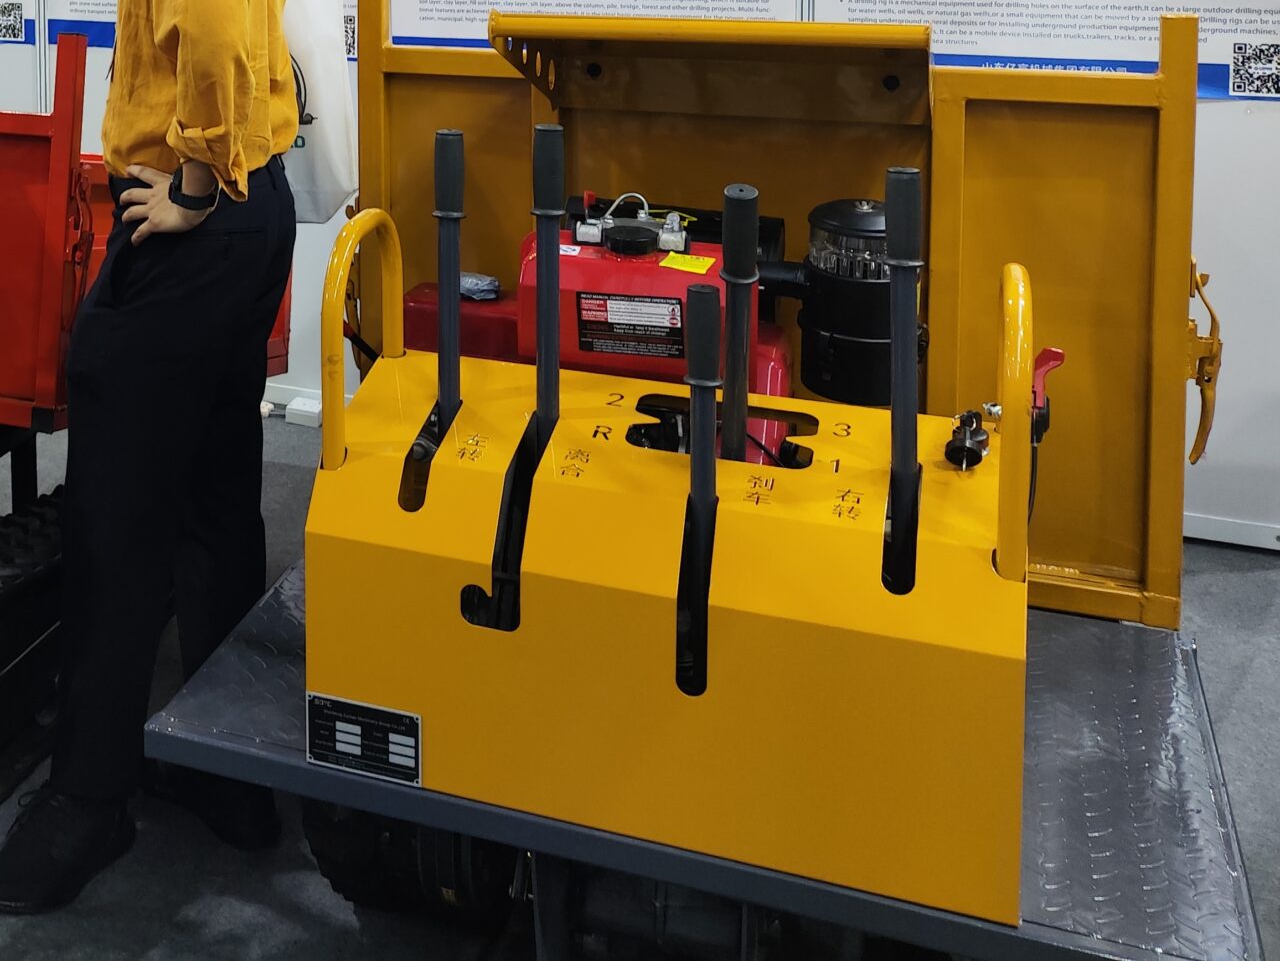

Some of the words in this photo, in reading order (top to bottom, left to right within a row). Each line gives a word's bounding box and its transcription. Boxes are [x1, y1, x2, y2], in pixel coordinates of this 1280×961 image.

[604, 392, 626, 408] 2
[591, 424, 613, 441] R
[832, 421, 852, 438] 3
[559, 447, 593, 478] 离合
[829, 458, 841, 474] 1
[742, 473, 776, 506] 刹车
[831, 487, 866, 522] 右转
